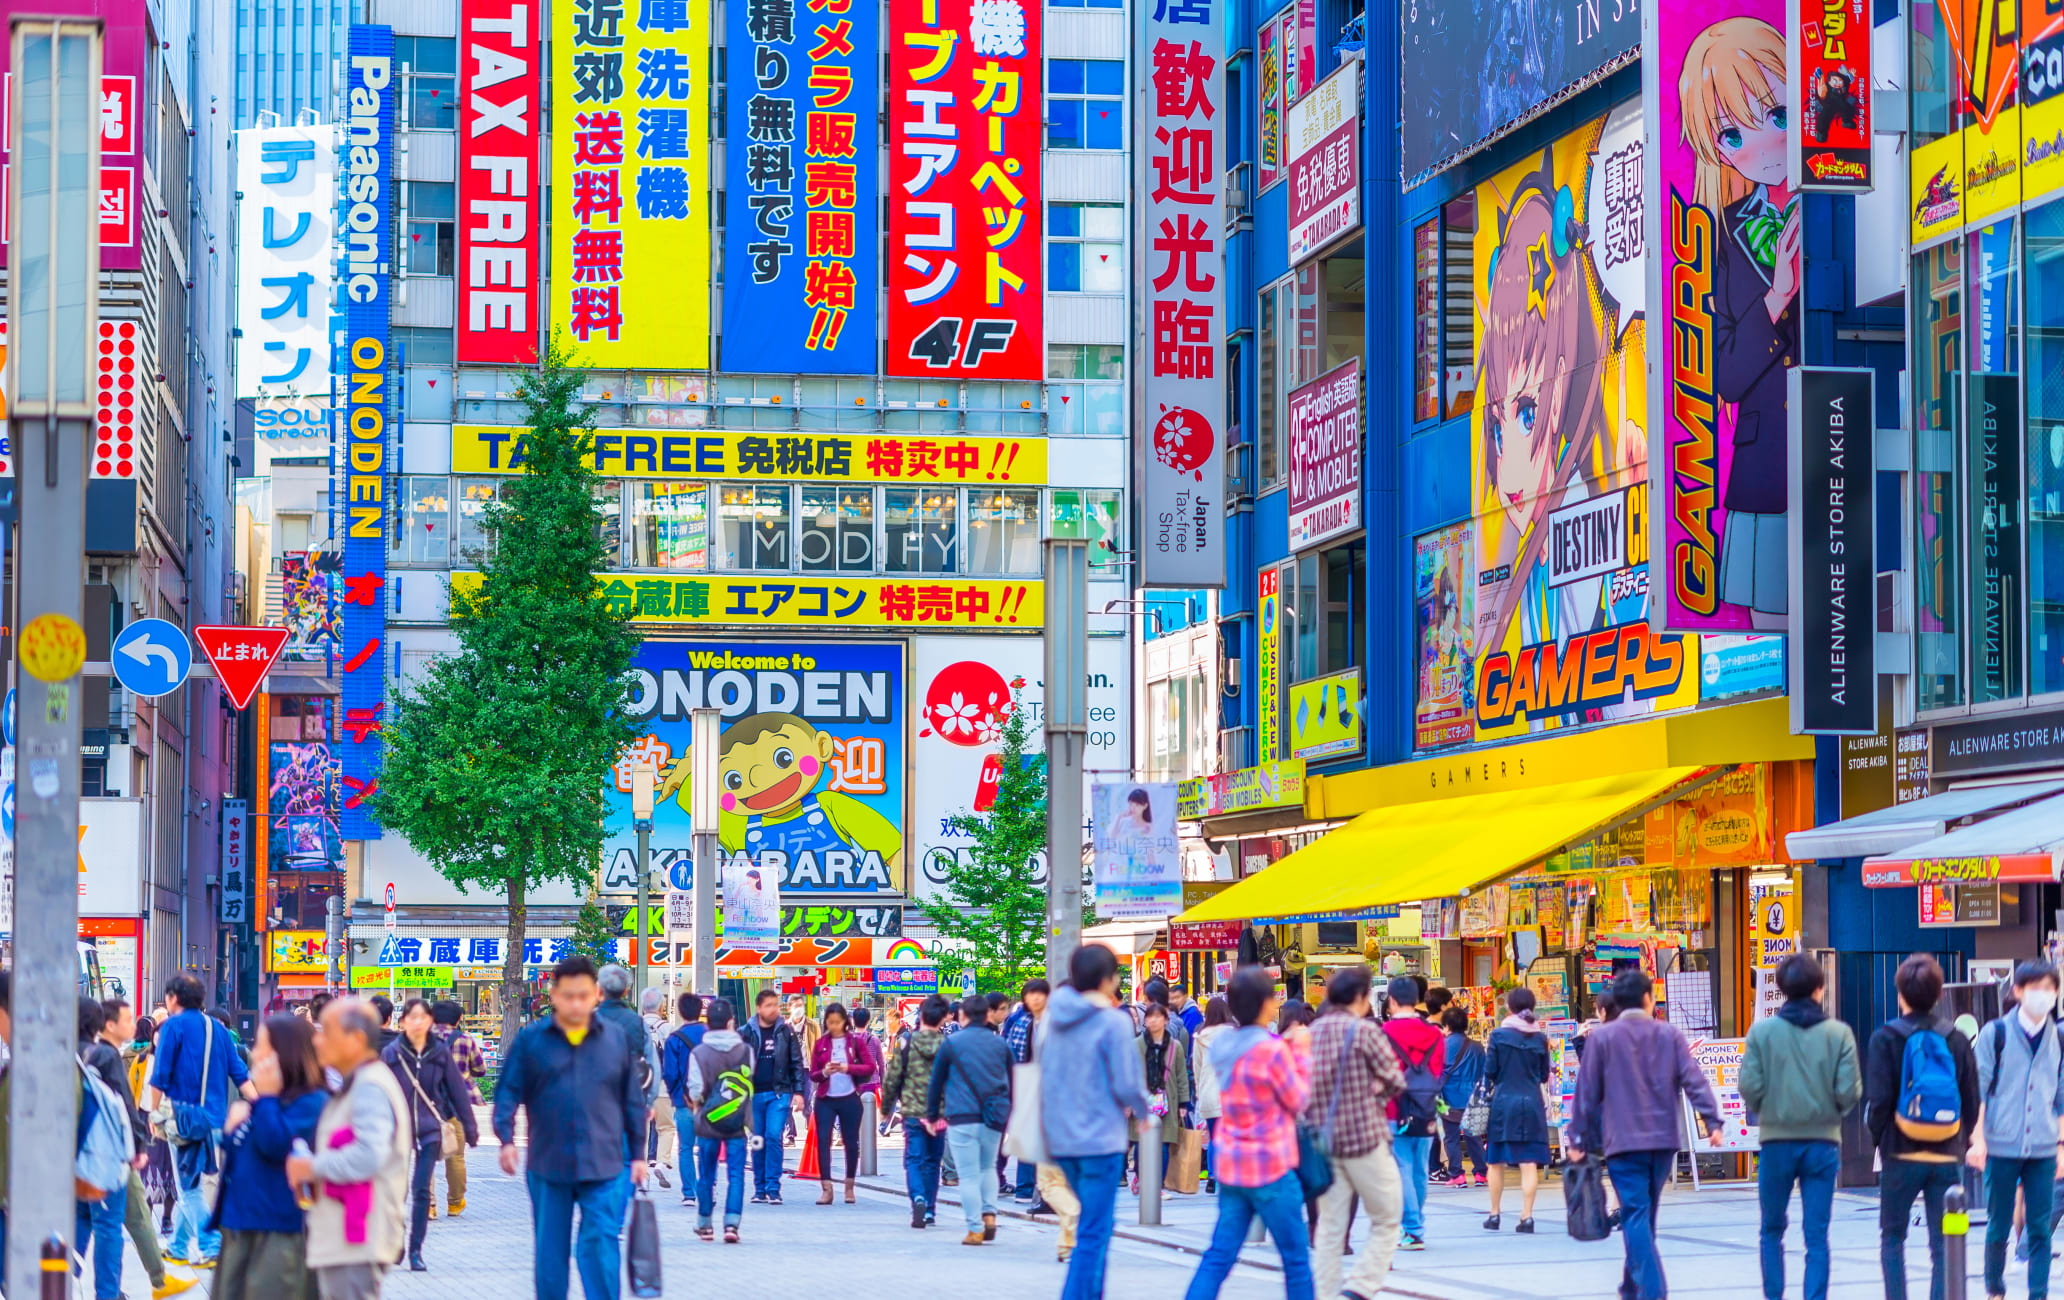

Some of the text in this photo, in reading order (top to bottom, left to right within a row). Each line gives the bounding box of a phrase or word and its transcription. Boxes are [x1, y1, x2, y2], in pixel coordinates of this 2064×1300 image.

[348, 55, 391, 304] Panasonic
[469, 4, 528, 333] TAX FREE
[1152, 38, 1216, 379] 歓迎光臨
[1308, 204, 1341, 250] TAKARADA
[261, 140, 316, 384] テレオン
[909, 316, 1017, 368] 4F
[1671, 200, 1718, 618] GAMERS
[349, 337, 386, 539] ONODEN
[594, 436, 725, 473] FREE
[737, 436, 852, 476] 免税店
[1307, 406, 1358, 466] COMPUTER
[1317, 448, 1359, 498] MOBILE
[1156, 512, 1173, 553] Shop
[1175, 488, 1190, 553] Tax-free
[1195, 495, 1210, 552] Japan.
[1308, 501, 1343, 540] TAKARADA
[1552, 503, 1621, 577] DESTINY
[1830, 397, 1846, 705] ALIENWARE STORE AKIBA
[601, 579, 710, 617] 冷蔵庫
[726, 583, 867, 618] エアコン
[213, 641, 269, 662] 止まれ
[688, 650, 815, 671] Welcome to
[1477, 622, 1683, 722] GAMERS
[617, 670, 891, 721] ONODEN
[1848, 735, 1888, 751] ALIENWARE
[1848, 754, 1888, 771] STORE AKIBA
[1949, 733, 2010, 757] ALIENWARE
[2013, 728, 2049, 750] STORE
[1430, 758, 1526, 788] GAMERS
[402, 967, 436, 977] 免税店
